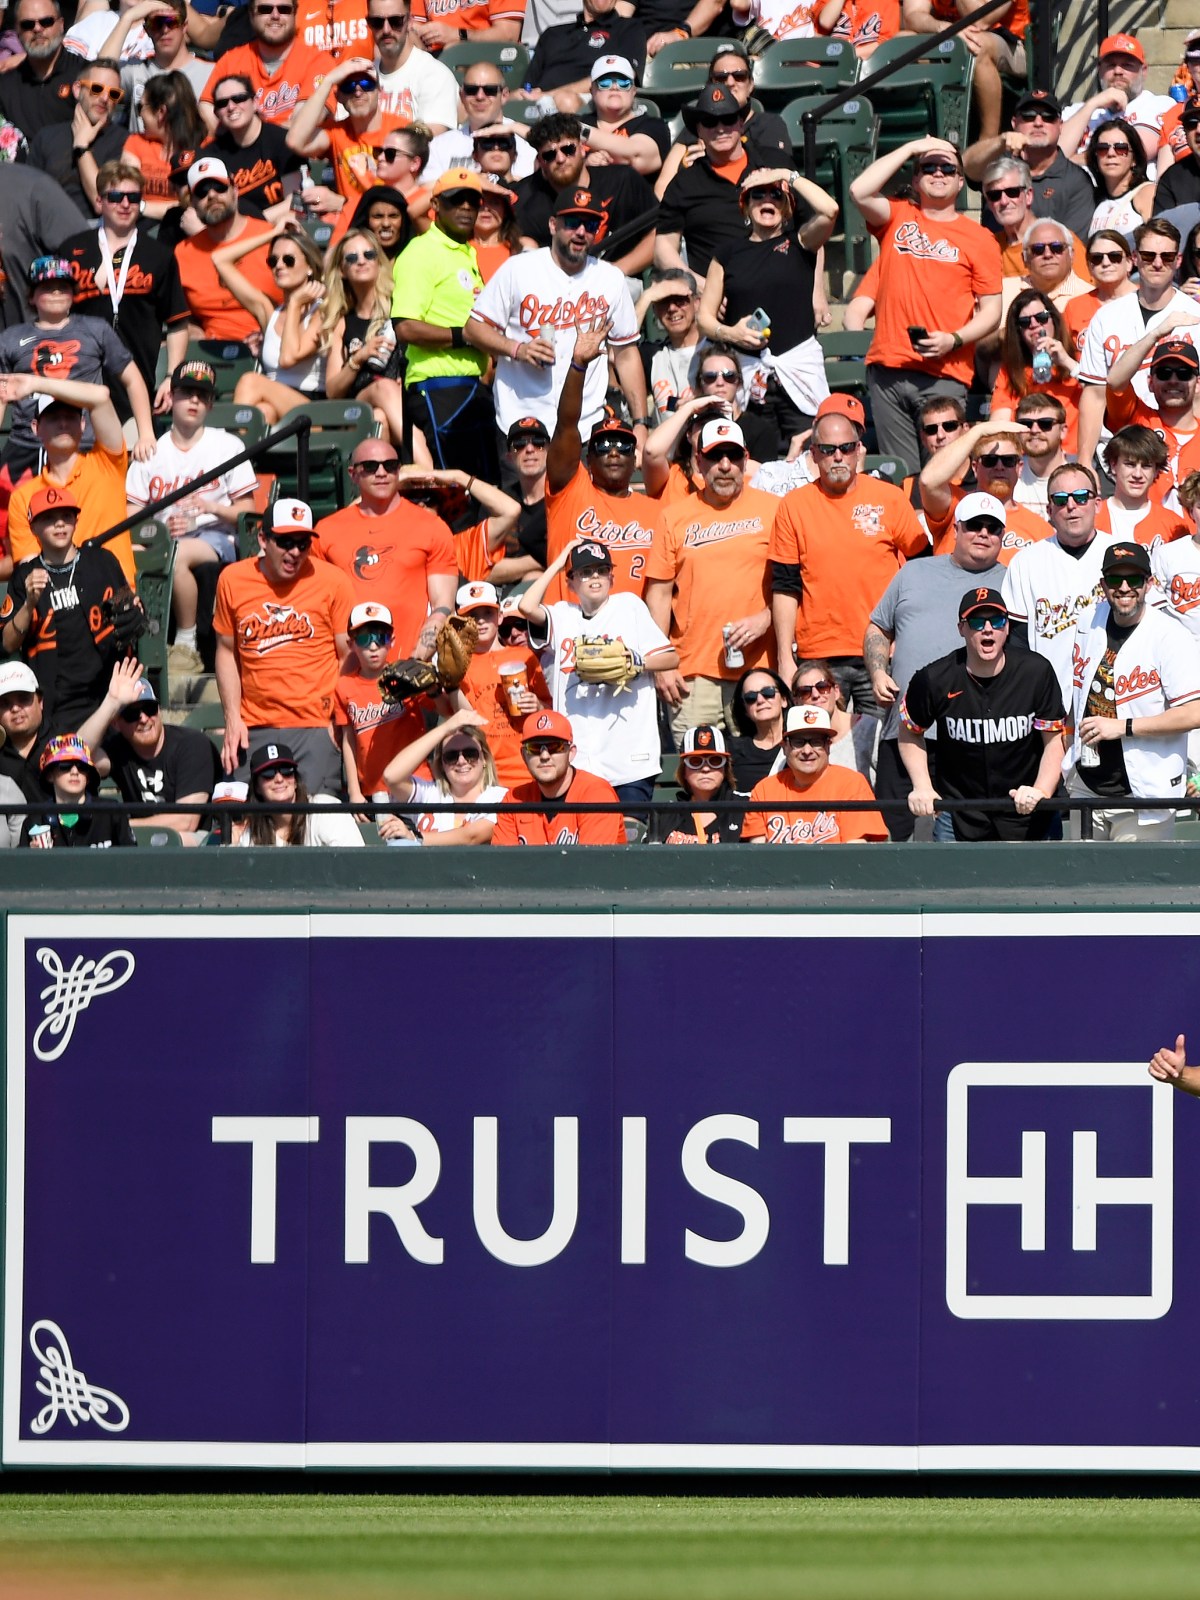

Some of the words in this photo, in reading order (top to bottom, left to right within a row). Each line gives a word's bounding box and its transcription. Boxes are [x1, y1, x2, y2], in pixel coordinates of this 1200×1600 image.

[520, 290, 610, 330] Orioles
[577, 506, 653, 539] Orioles
[682, 515, 764, 546] Baltimore
[629, 554, 646, 578] 2
[238, 612, 309, 642] Orioles
[944, 711, 1036, 743] BALTIMORE
[212, 1113, 891, 1268] TRUIST
